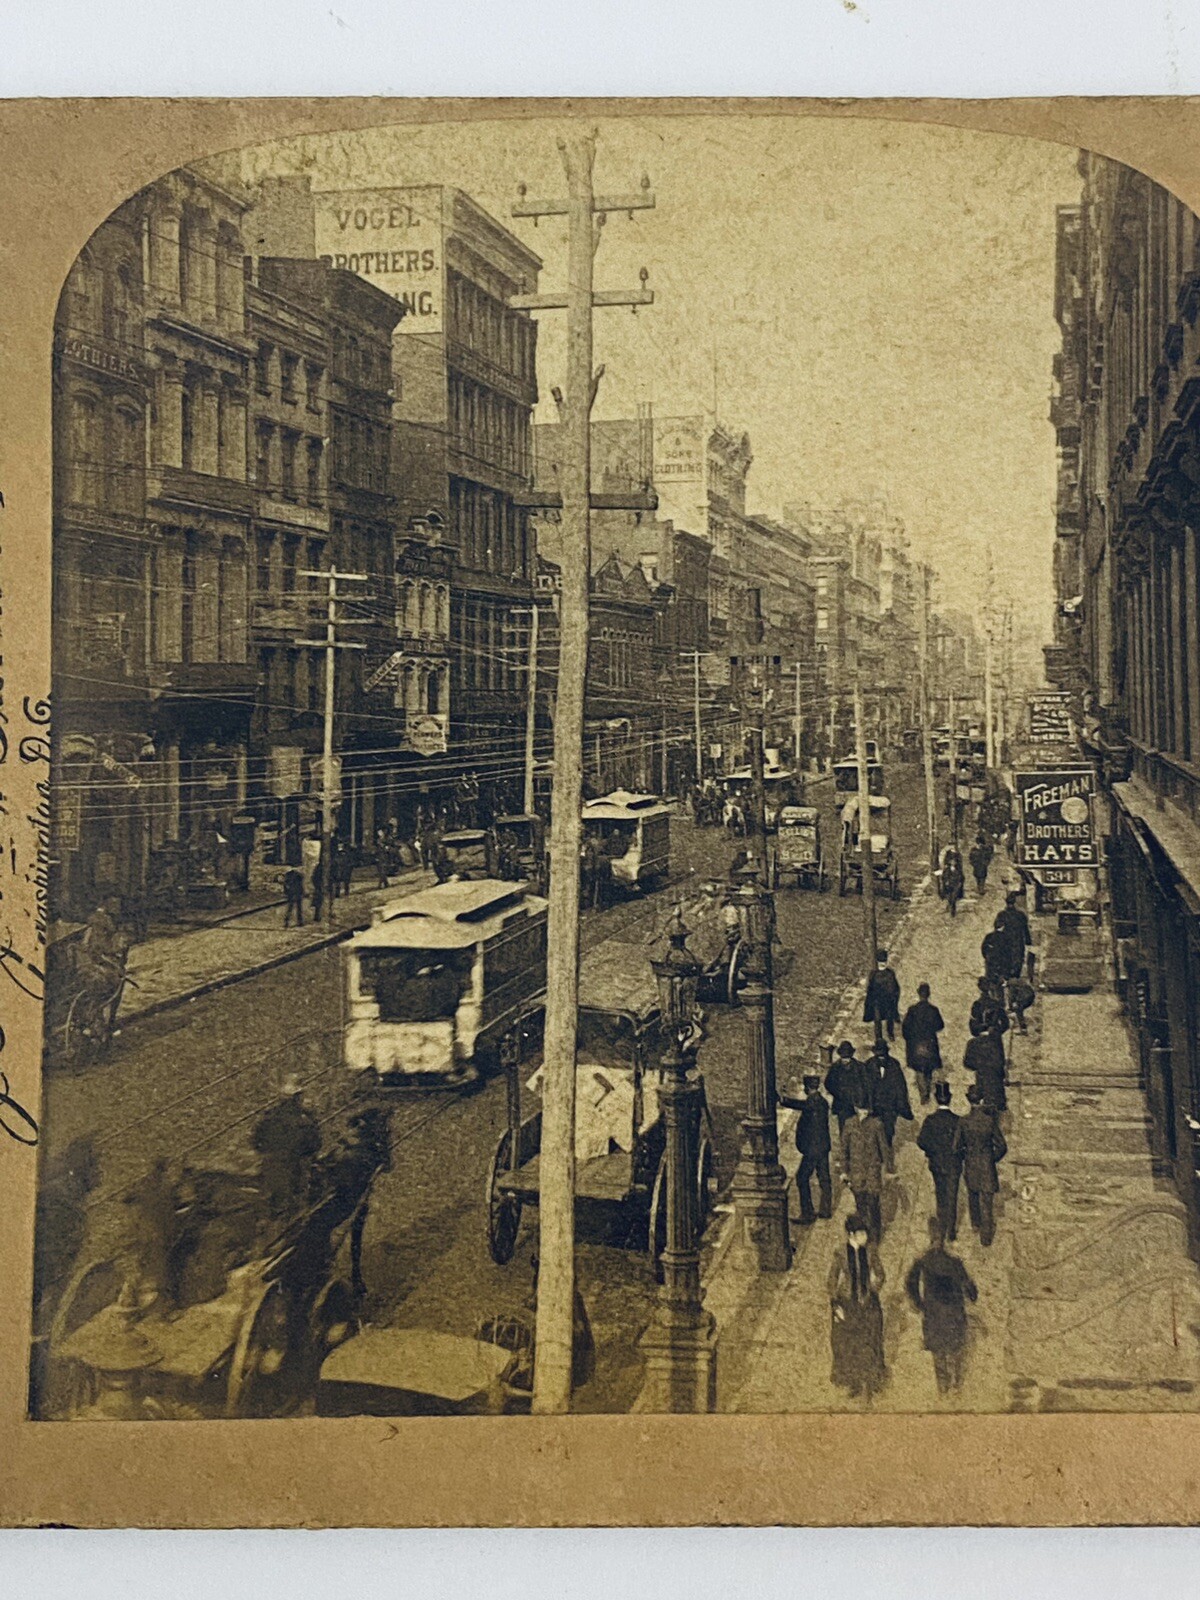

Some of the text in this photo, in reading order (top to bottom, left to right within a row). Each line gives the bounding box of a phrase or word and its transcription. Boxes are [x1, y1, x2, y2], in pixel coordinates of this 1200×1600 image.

[335, 205, 420, 231] VOGEL
[1024, 775, 1090, 813] FREEMAN
[1027, 823, 1090, 839] BROTHERS
[1024, 844, 1093, 861] HATS
